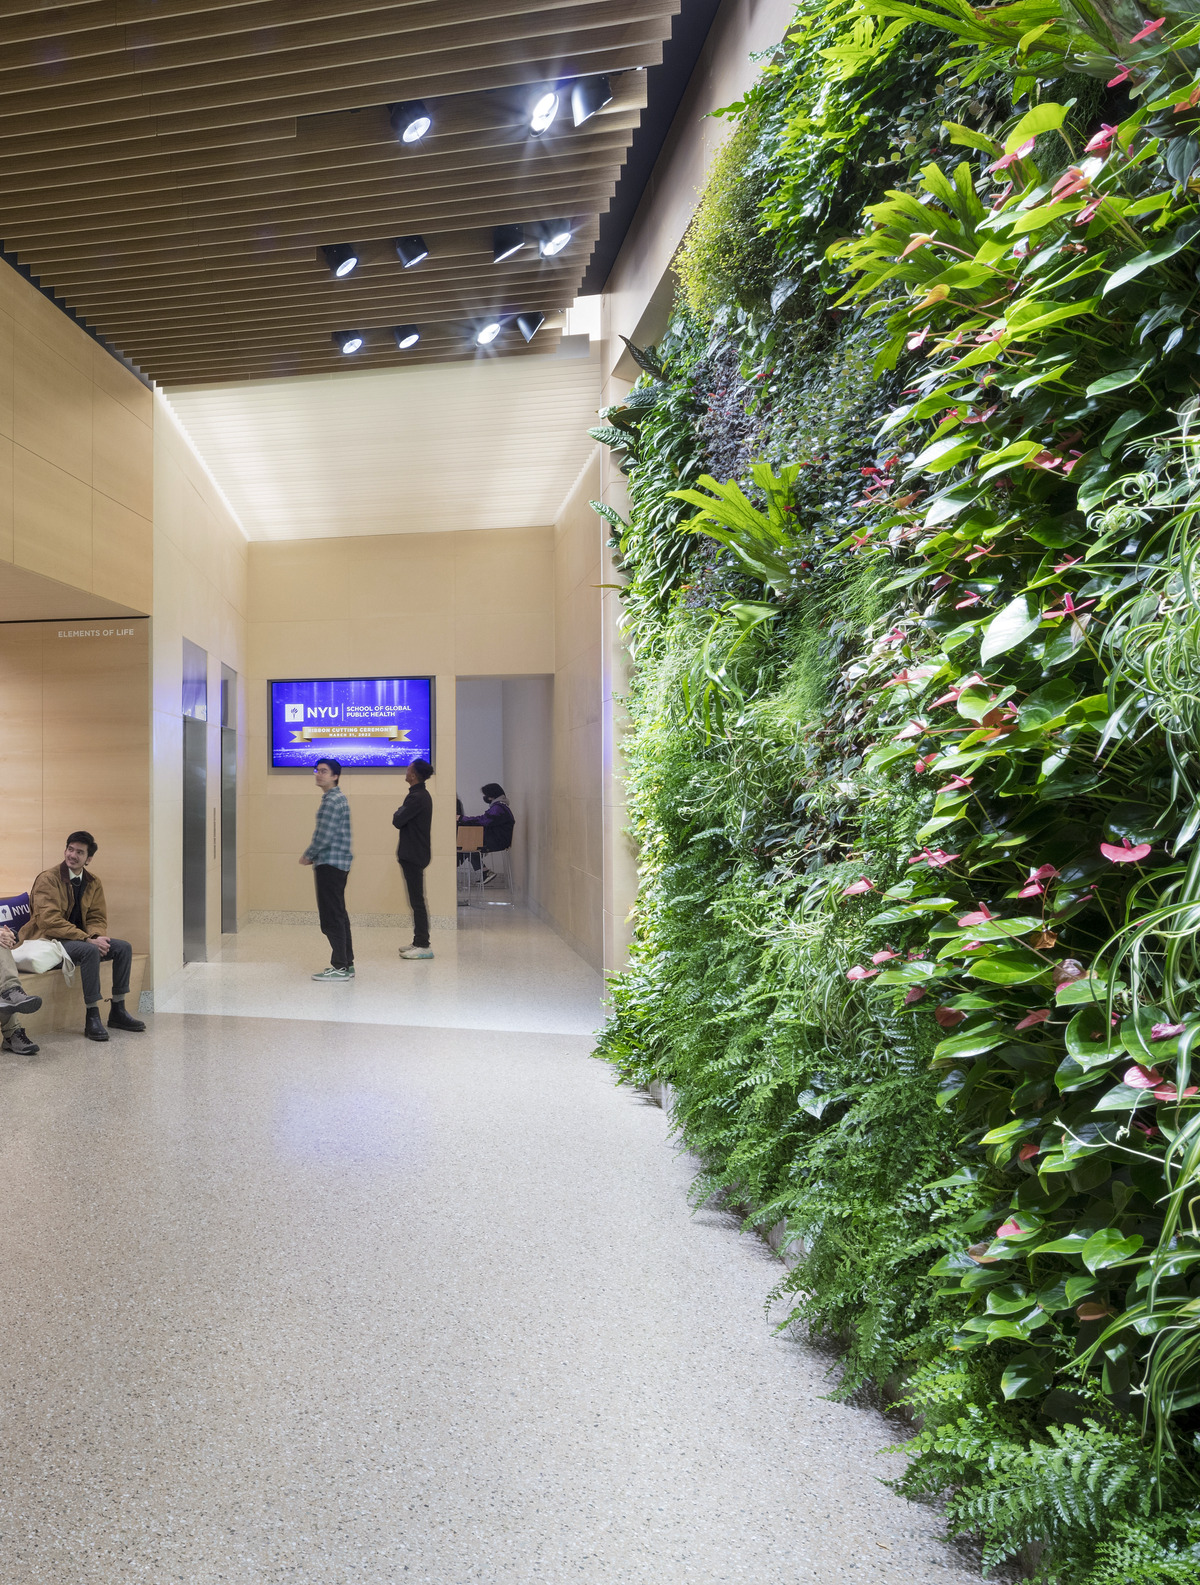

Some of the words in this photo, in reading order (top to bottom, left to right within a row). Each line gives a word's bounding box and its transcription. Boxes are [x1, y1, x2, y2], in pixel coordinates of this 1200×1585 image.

[57, 629, 101, 638] ELEMENTS
[116, 628, 134, 636] LIFE
[307, 706, 339, 718] NYU
[11, 903, 31, 916] NYU
